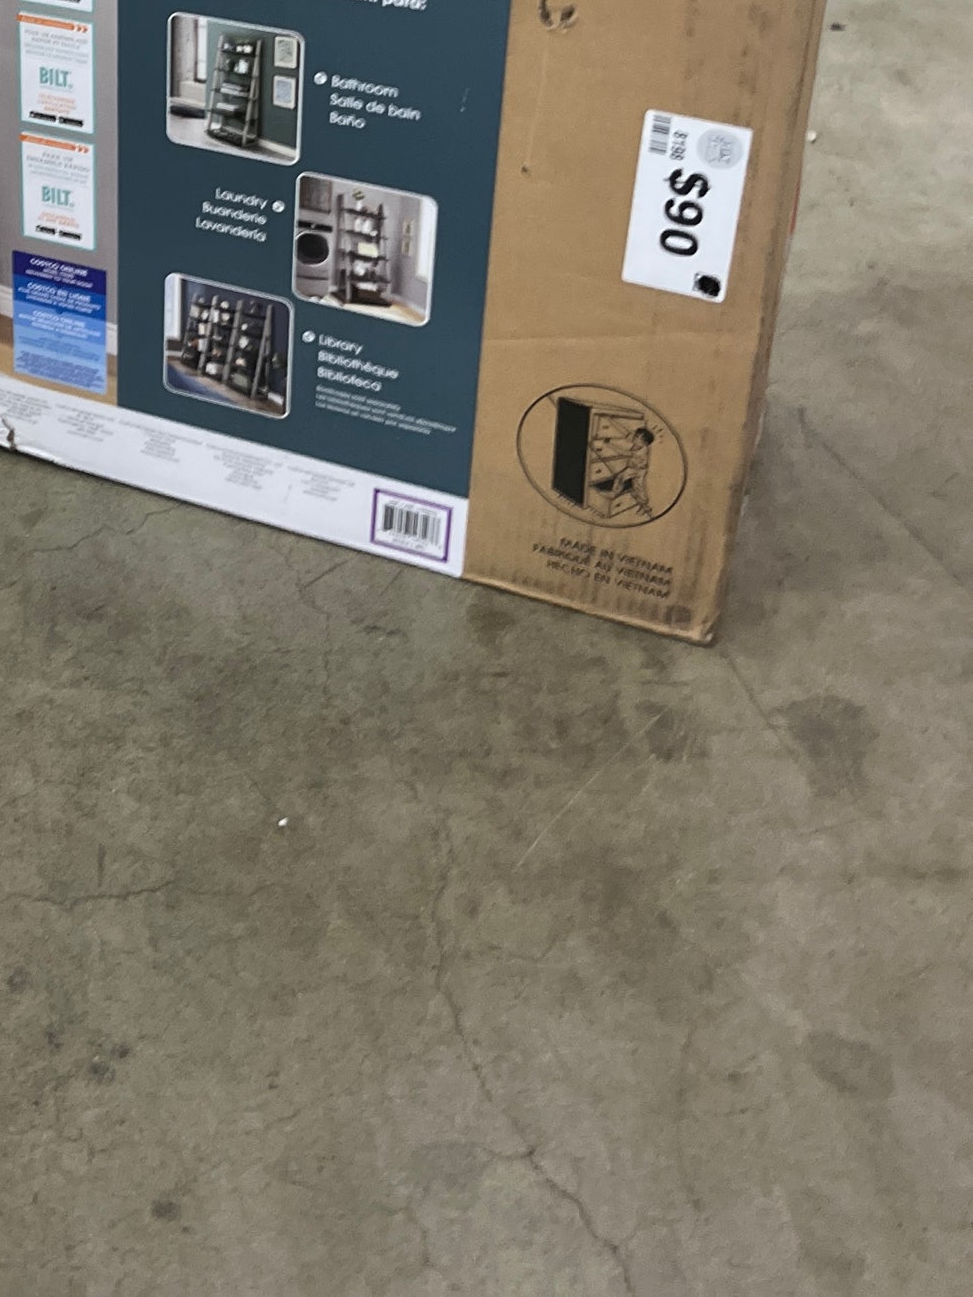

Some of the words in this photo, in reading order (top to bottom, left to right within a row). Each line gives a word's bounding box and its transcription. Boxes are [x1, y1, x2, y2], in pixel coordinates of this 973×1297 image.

[39, 66, 70, 88] BILT
[331, 74, 400, 98] Bathroom
[330, 92, 364, 110] Salle
[365, 100, 387, 114] de
[388, 103, 421, 121] bain
[329, 110, 367, 129] Baño
[41, 185, 71, 207] BILT
[215, 186, 268, 210] Laundry
[202, 201, 267, 226] Buanderie
[658, 167, 714, 258] $90
[195, 216, 267, 243] Lavandería
[318, 333, 364, 355] Library
[317, 349, 400, 380] Bibliothèque
[317, 366, 383, 393] Biblioteca
[559, 537, 597, 553] MADE
[599, 549, 615, 560] IN
[617, 553, 673, 574] VIETNAM
[546, 559, 591, 579] HECHO
[593, 571, 611, 584] EN
[614, 579, 671, 599] VIETNAM
[616, 567, 672, 586] VIETNAM
